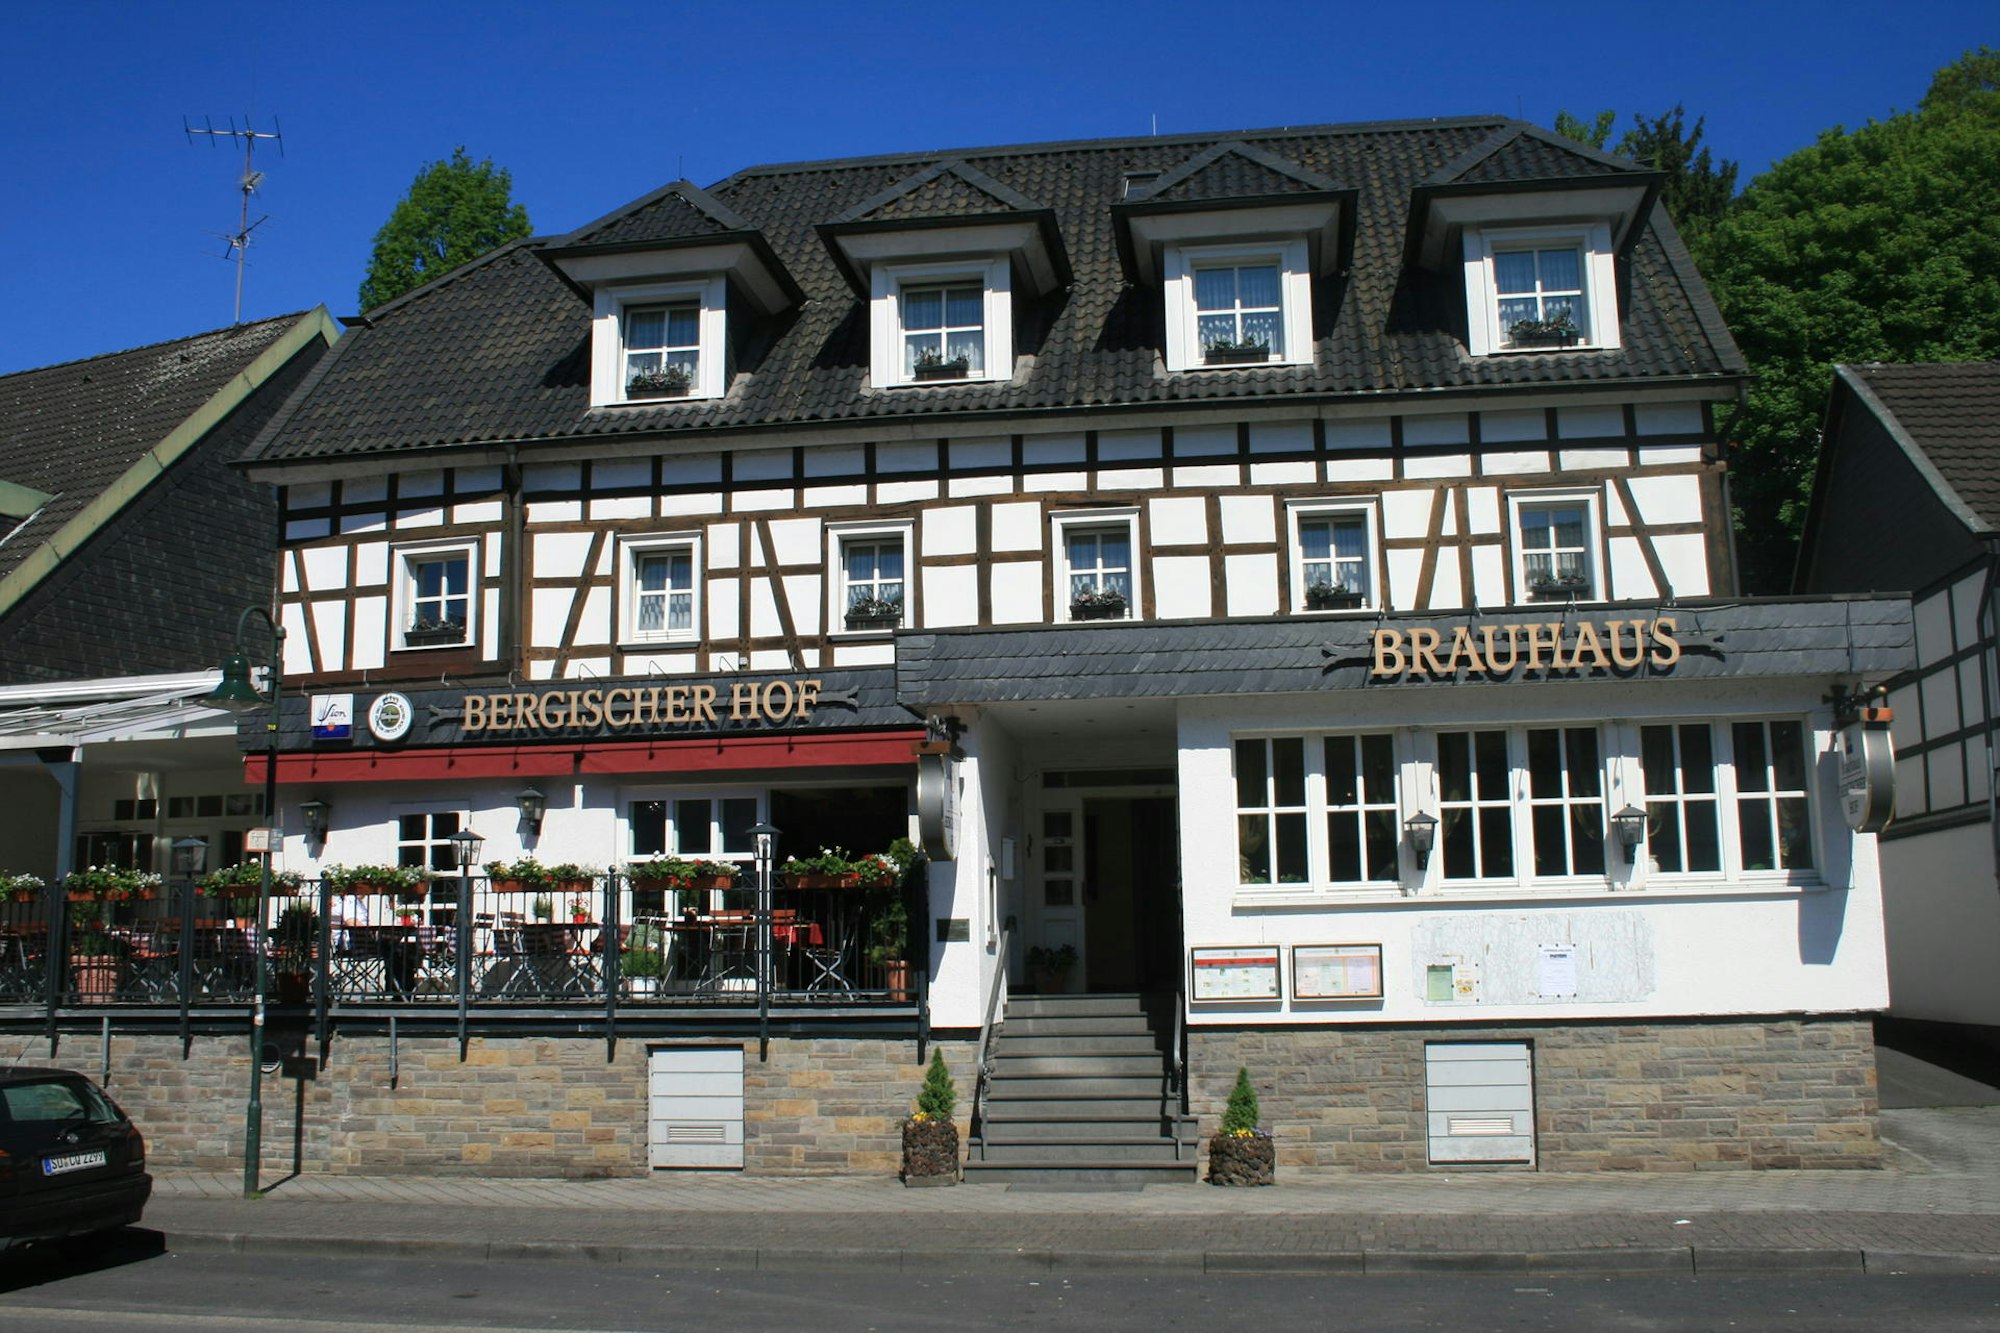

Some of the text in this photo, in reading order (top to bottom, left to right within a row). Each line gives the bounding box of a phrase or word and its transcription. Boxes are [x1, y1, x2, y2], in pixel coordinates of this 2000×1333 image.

[1371, 617, 1681, 675] BRAUHAUS
[318, 703, 346, 722] Sion
[462, 679, 823, 731] BERGISCHER HOF
